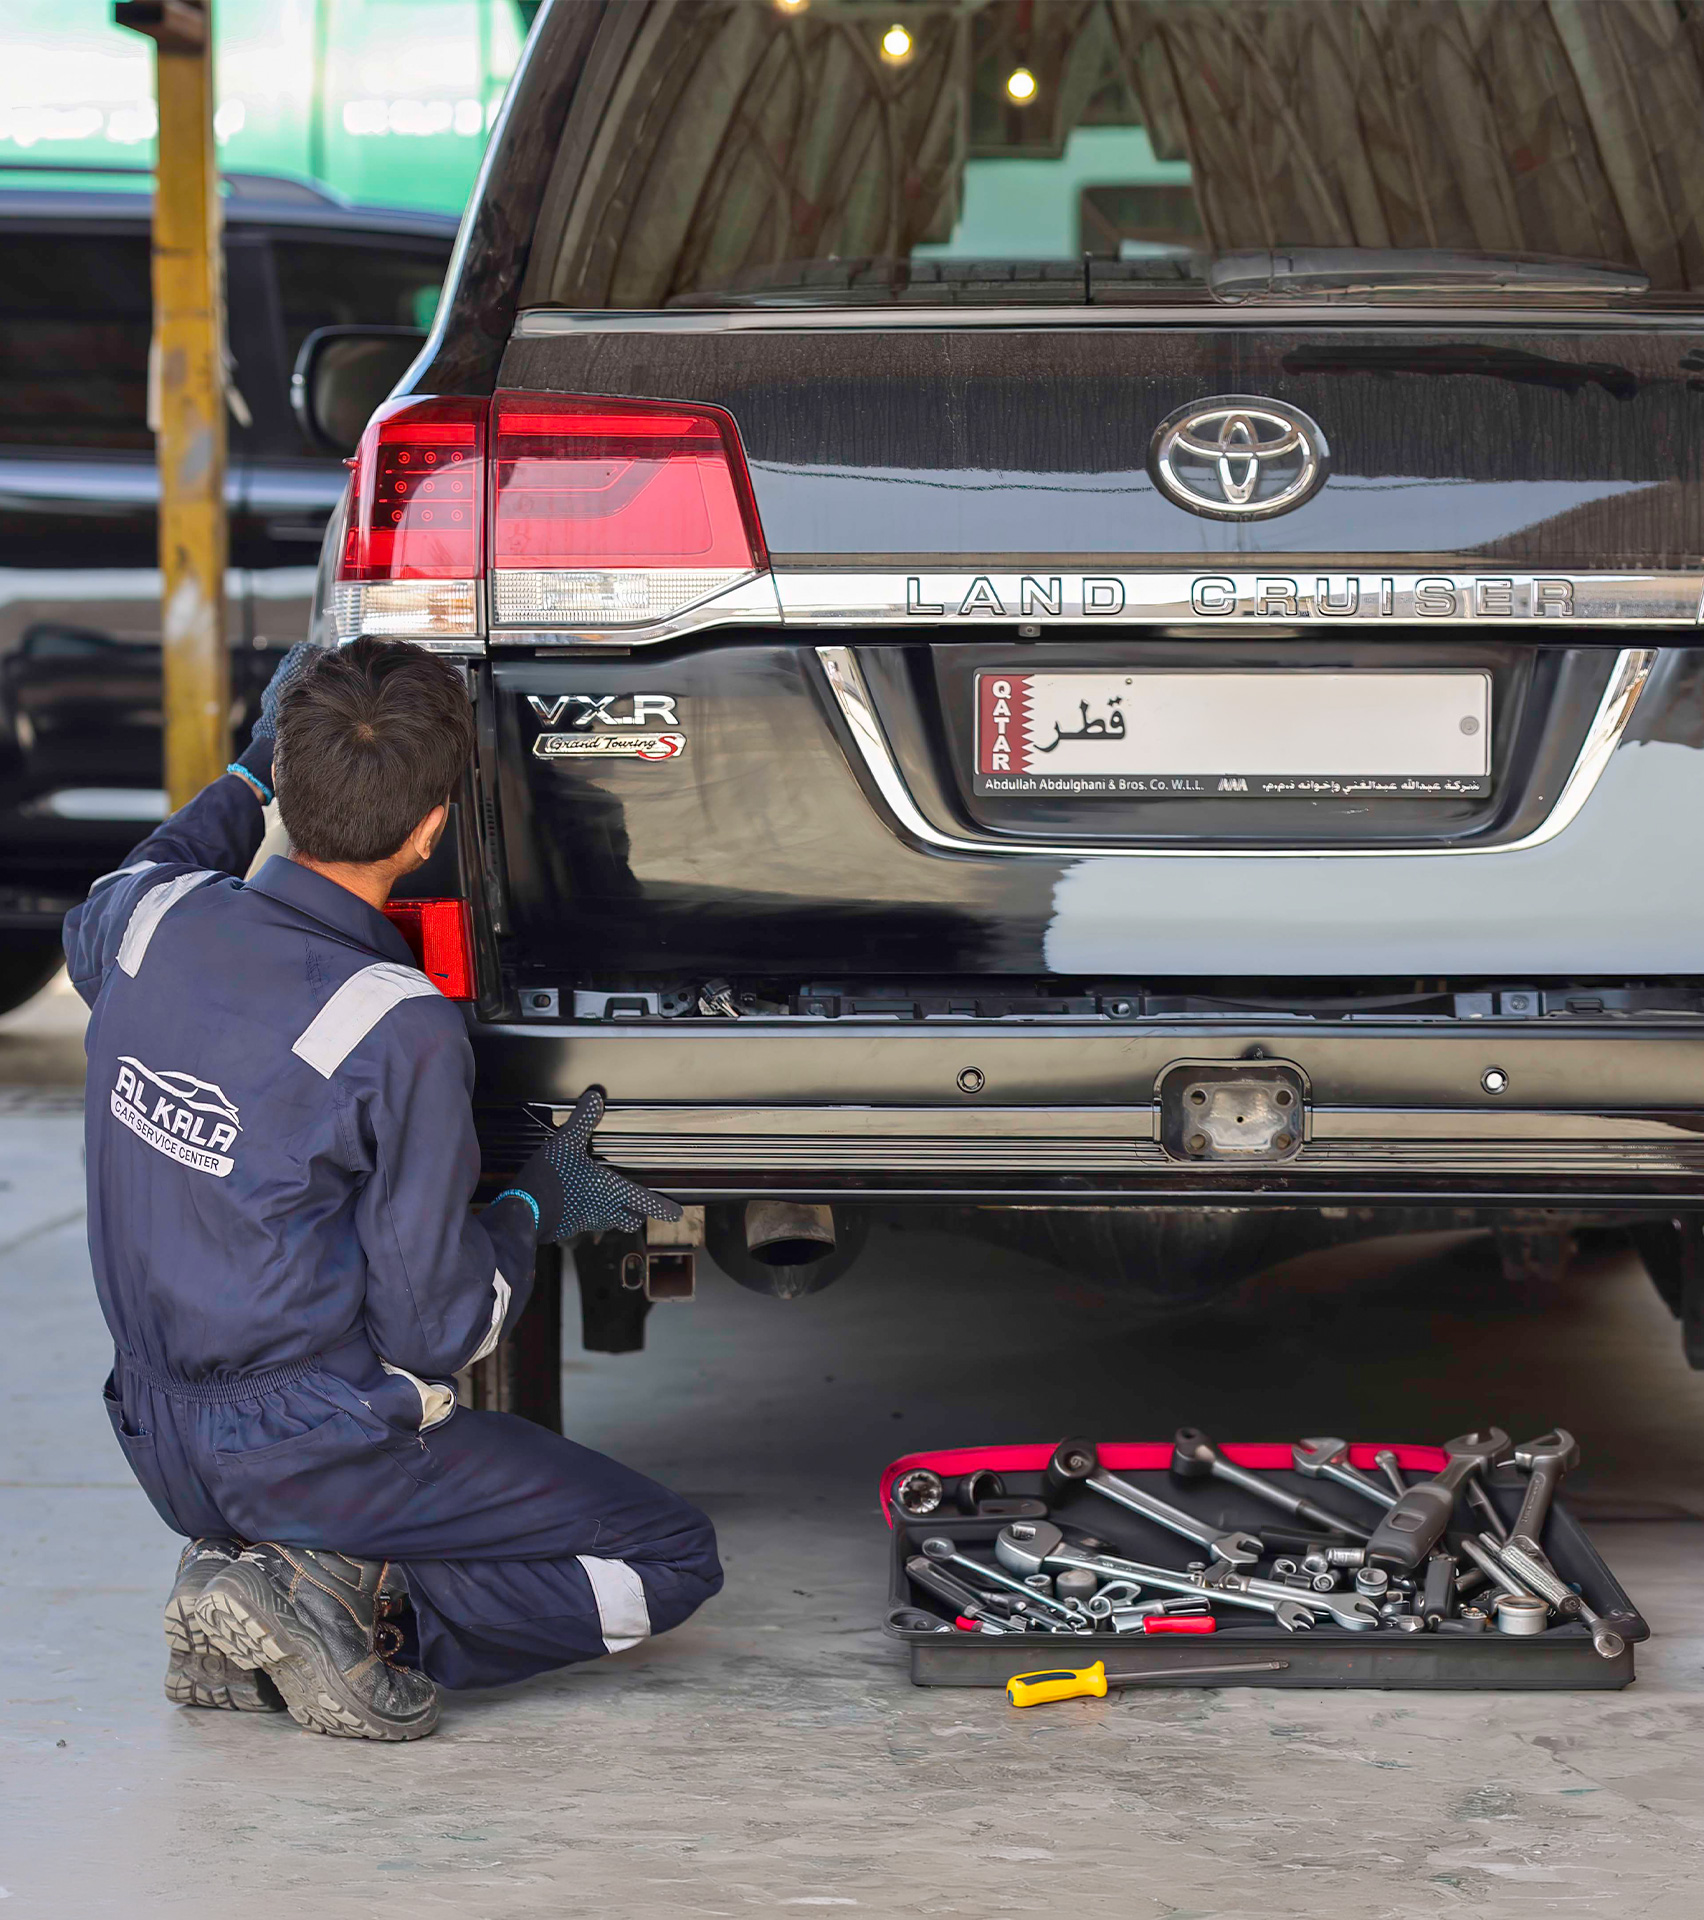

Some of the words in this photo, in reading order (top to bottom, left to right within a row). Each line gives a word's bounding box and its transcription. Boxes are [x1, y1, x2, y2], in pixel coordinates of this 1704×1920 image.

[907, 576, 1126, 616] LAND
[1190, 576, 1575, 617] CRUISER
[548, 736, 600, 750] Grand
[604, 736, 658, 750] Touring
[991, 680, 1013, 771] QATAR
[1033, 696, 1127, 753] قطر
[985, 778, 1037, 791] Abdullah
[1039, 778, 1106, 793] Abdulghani
[1108, 779, 1117, 791] &
[1119, 779, 1148, 791] Bros.
[1150, 779, 1169, 791] Co.
[1171, 779, 1205, 791] W.L.L.
[1444, 779, 1480, 793] شركة
[115, 1065, 148, 1114] AL
[150, 1096, 238, 1153] KALA
[114, 1100, 136, 1125] CAR
[136, 1119, 178, 1155] SERVICE
[178, 1146, 220, 1171] CENTER
